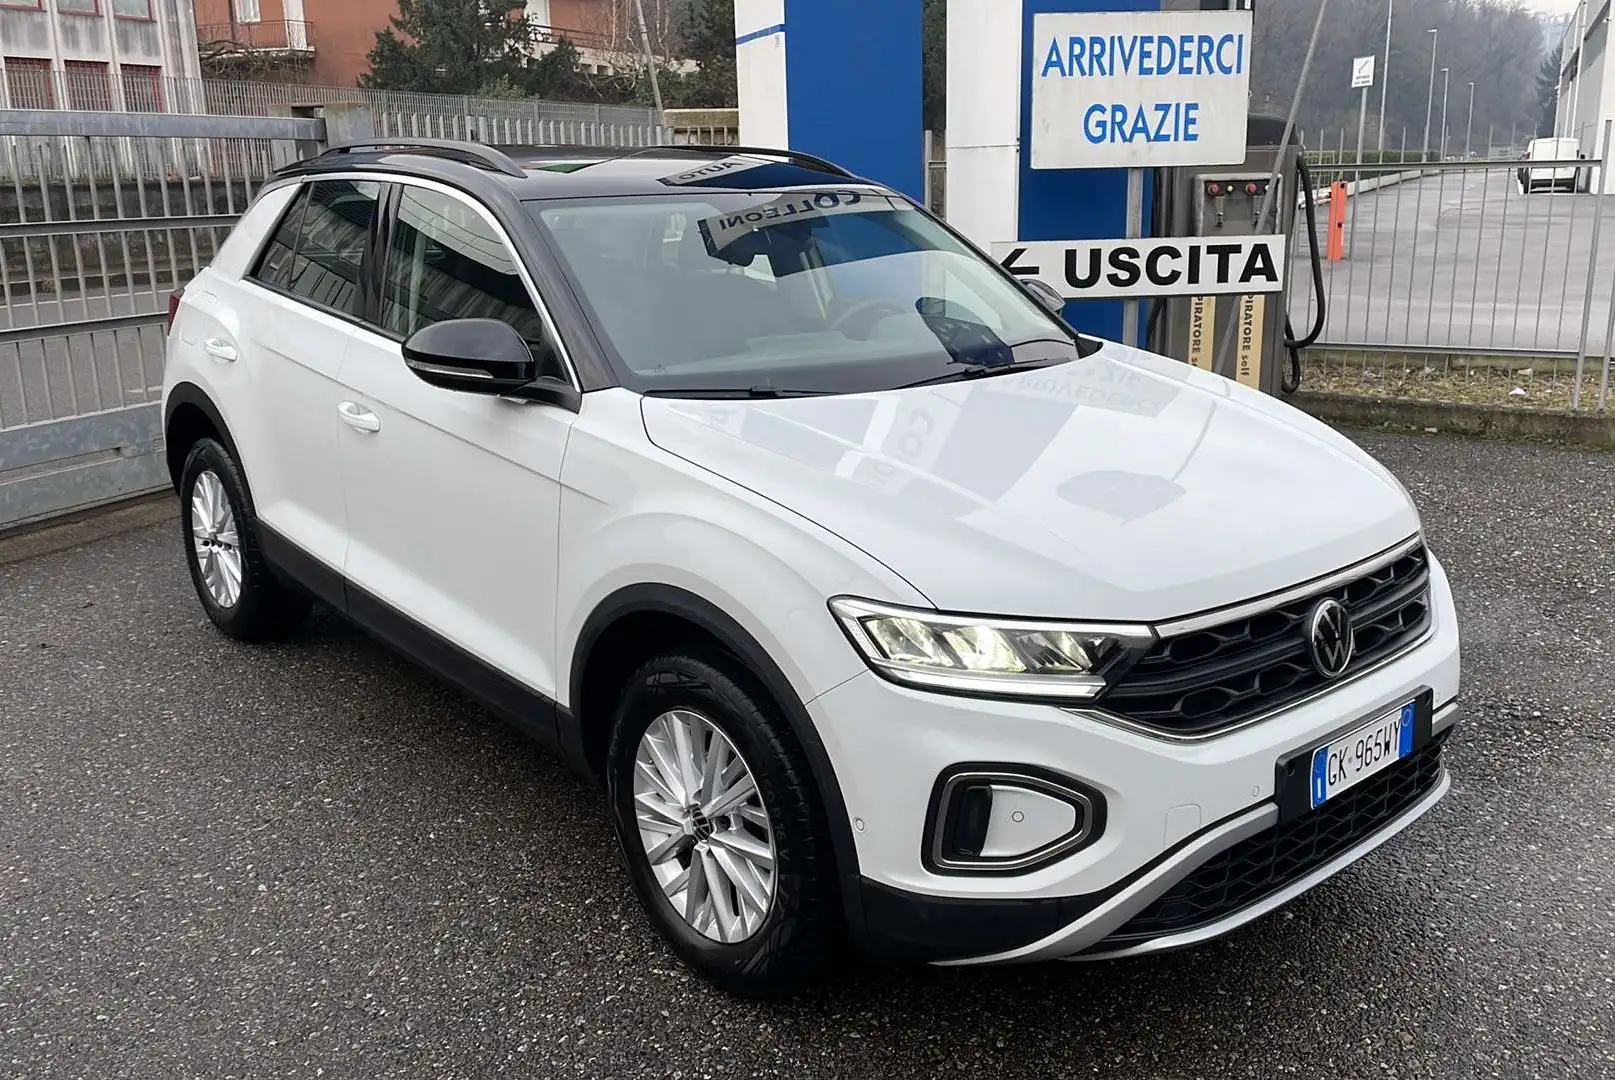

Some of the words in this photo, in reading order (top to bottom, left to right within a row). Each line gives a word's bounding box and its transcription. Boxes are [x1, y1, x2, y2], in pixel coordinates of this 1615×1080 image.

[1041, 33, 1244, 77] ARRIVEDERCI
[1083, 102, 1200, 144] GRAZIE
[1064, 242, 1279, 289] USCITA
[1327, 746, 1350, 787] GK
[1355, 719, 1402, 773] 965WY
